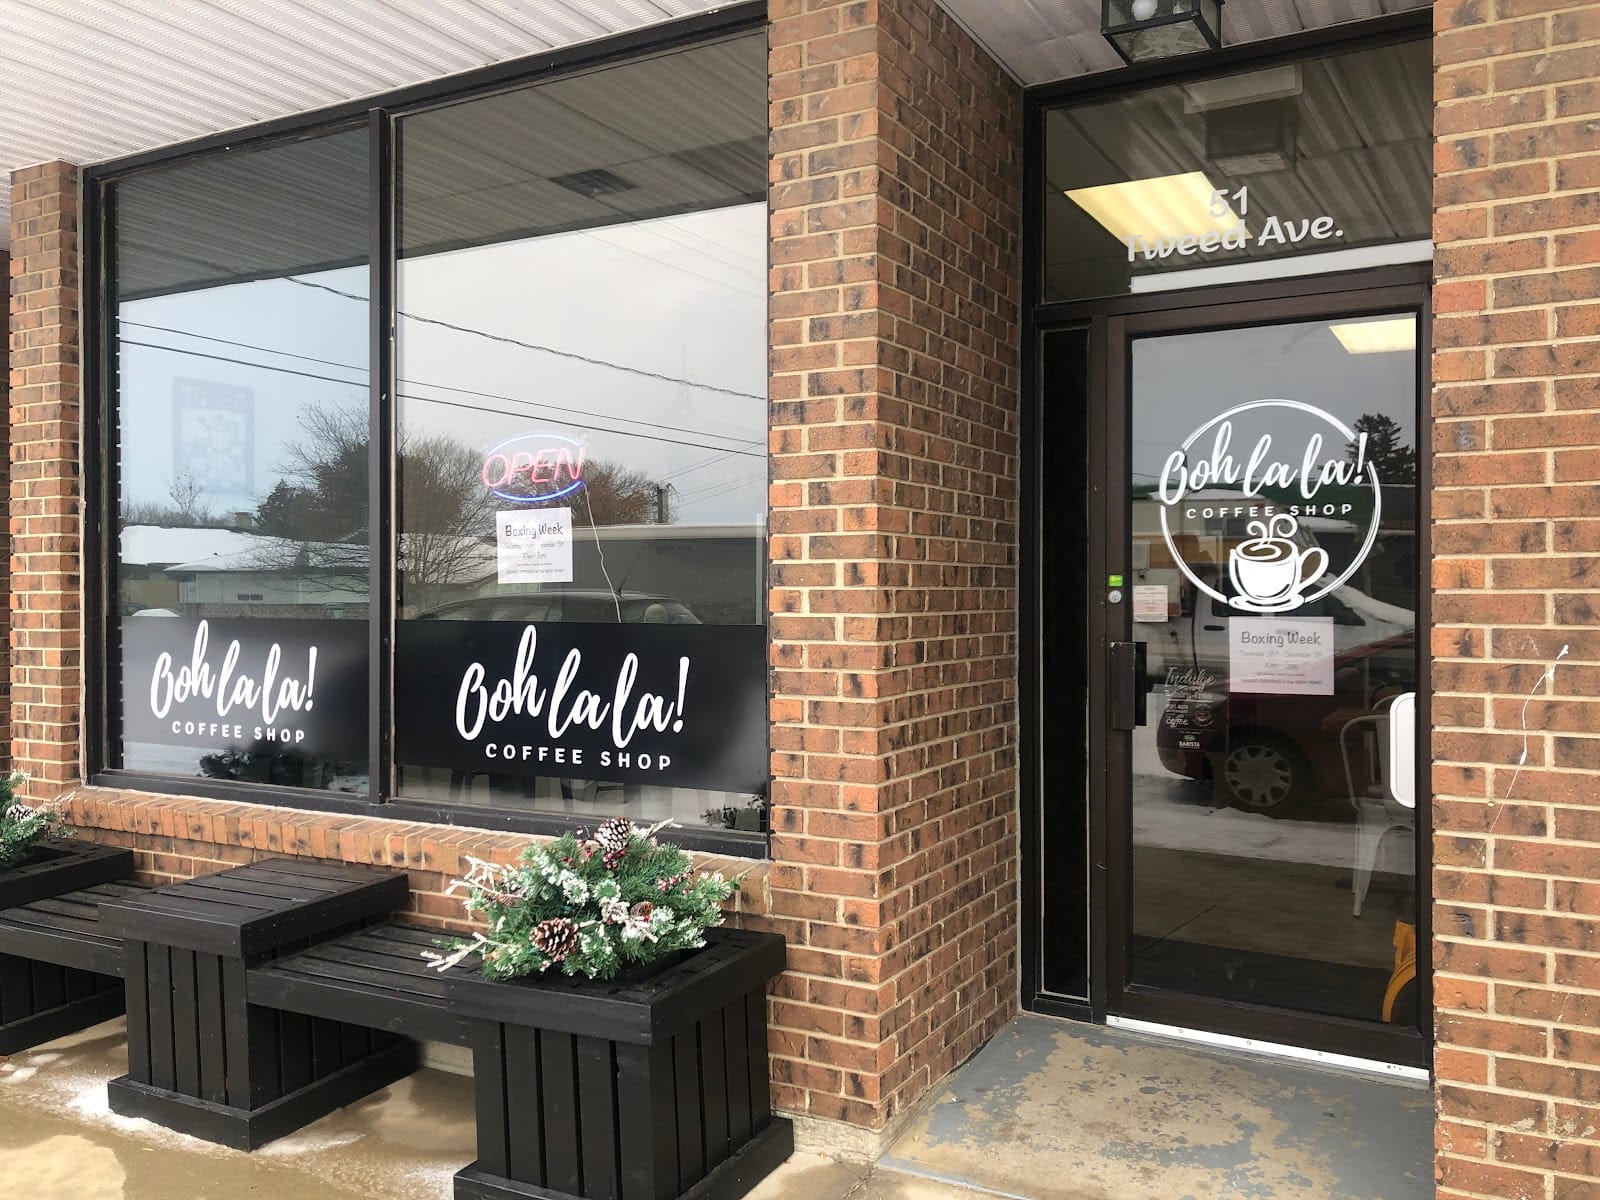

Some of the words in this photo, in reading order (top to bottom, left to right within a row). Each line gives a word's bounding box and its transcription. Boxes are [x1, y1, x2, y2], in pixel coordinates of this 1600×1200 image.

[1208, 186, 1248, 219] 51
[1126, 219, 1247, 262] Tweed
[1258, 213, 1344, 247] Ave.
[482, 446, 586, 488] OPEN
[1242, 434, 1298, 498] la
[1300, 432, 1368, 499] la!
[1186, 505, 1275, 519] COFFEE
[1290, 503, 1353, 517] SHOP
[505, 524, 537, 539] Boxing
[538, 522, 563, 535] Week
[1241, 631, 1284, 648] Boxing
[1287, 631, 1322, 645] Week
[216, 639, 261, 717] la
[262, 643, 318, 725] la!
[548, 648, 610, 739] la
[612, 652, 690, 749] la!
[172, 720, 242, 739] COFFEE
[254, 726, 305, 744] SHOP
[485, 743, 583, 765] COFFEE
[600, 751, 671, 771] SHOP
